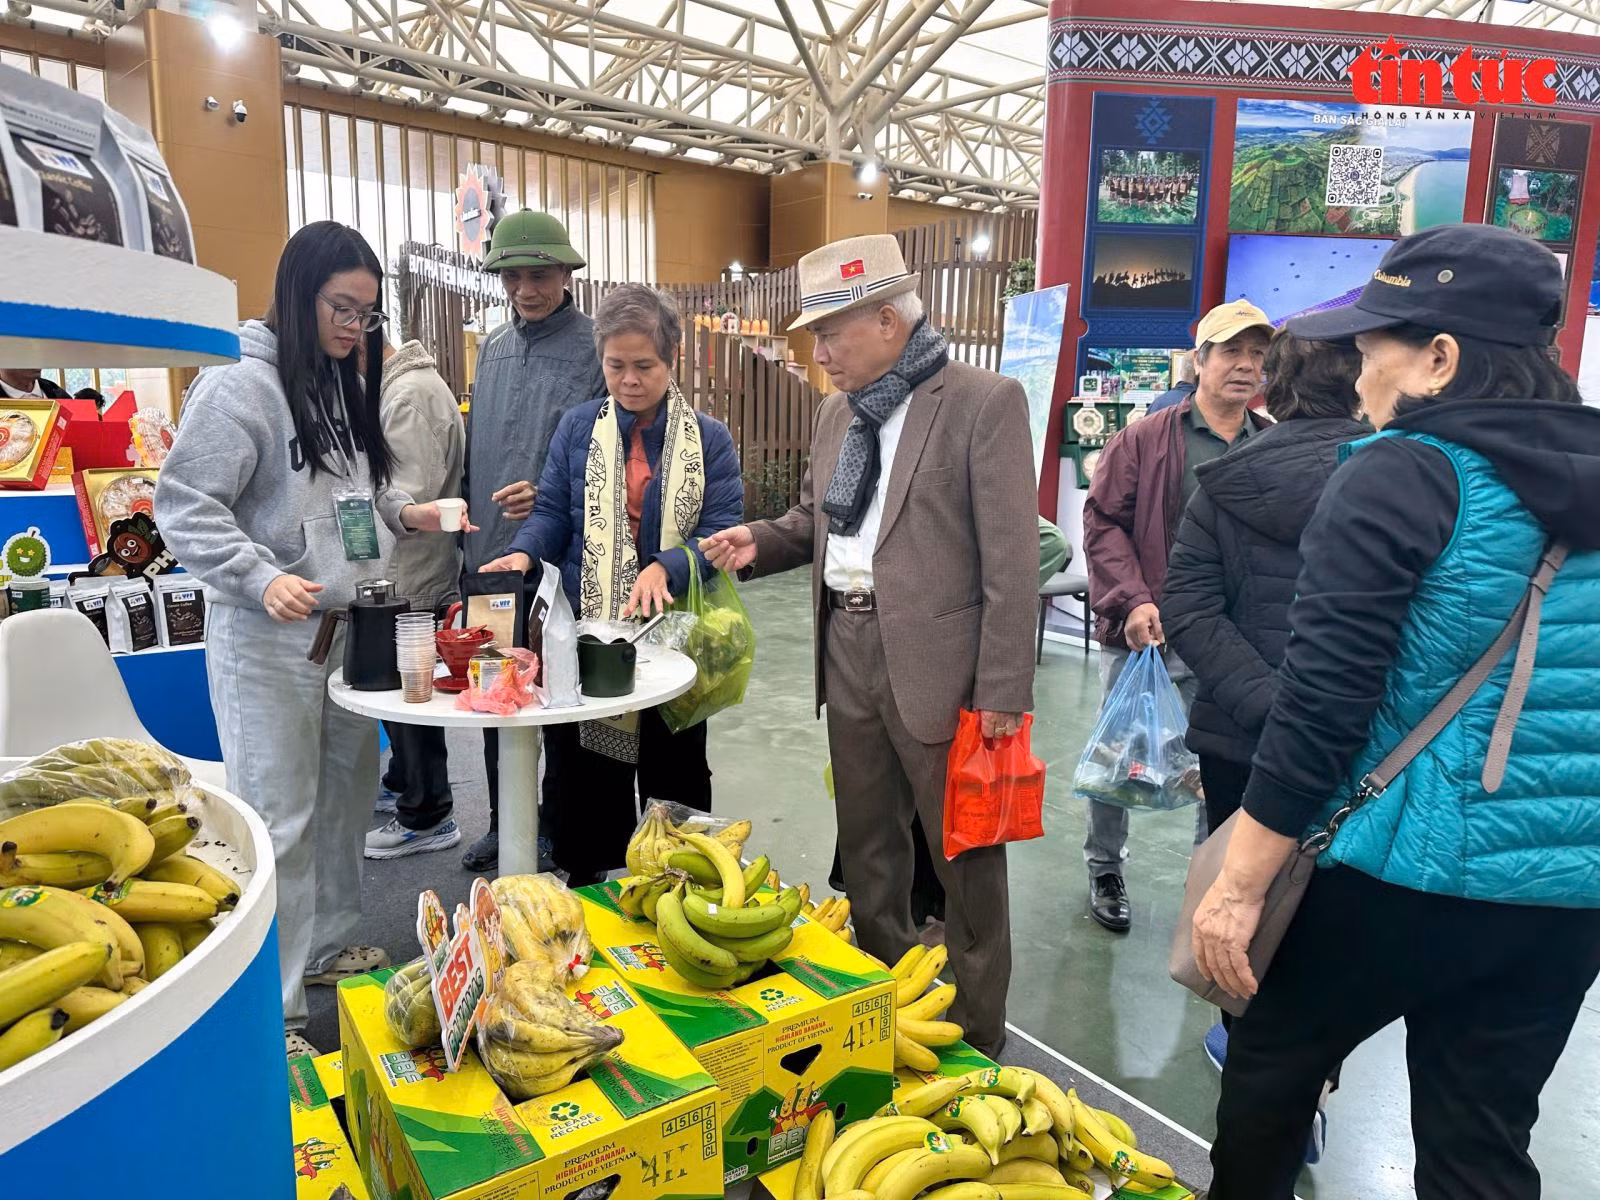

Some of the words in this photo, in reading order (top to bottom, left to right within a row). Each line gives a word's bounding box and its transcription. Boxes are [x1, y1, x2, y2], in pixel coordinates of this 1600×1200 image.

[1373, 269, 1412, 288] Columbia
[438, 932, 474, 1022] BEST
[782, 1015, 820, 1033] PREMIUM
[767, 1039, 797, 1054] PRODUCT
[797, 1036, 807, 1044] OF
[807, 1026, 834, 1041] VIETNAM
[550, 1112, 596, 1133] PLEASE
[550, 1115, 604, 1140] RECYCLE
[665, 1122, 673, 1133] 4
[679, 1117, 686, 1128] 5
[692, 1111, 699, 1122] 6
[705, 1105, 712, 1117] 7
[706, 1119, 713, 1130] 8
[706, 1132, 713, 1143] 9
[555, 1159, 594, 1181] HIGHLAND
[594, 1146, 627, 1165] BANANA
[563, 1141, 617, 1168] PREMIUM
[705, 1145, 716, 1157] CL
[544, 1173, 586, 1194] PRODUCT
[586, 1167, 598, 1179] OF
[600, 1151, 638, 1175] VIETNAM
